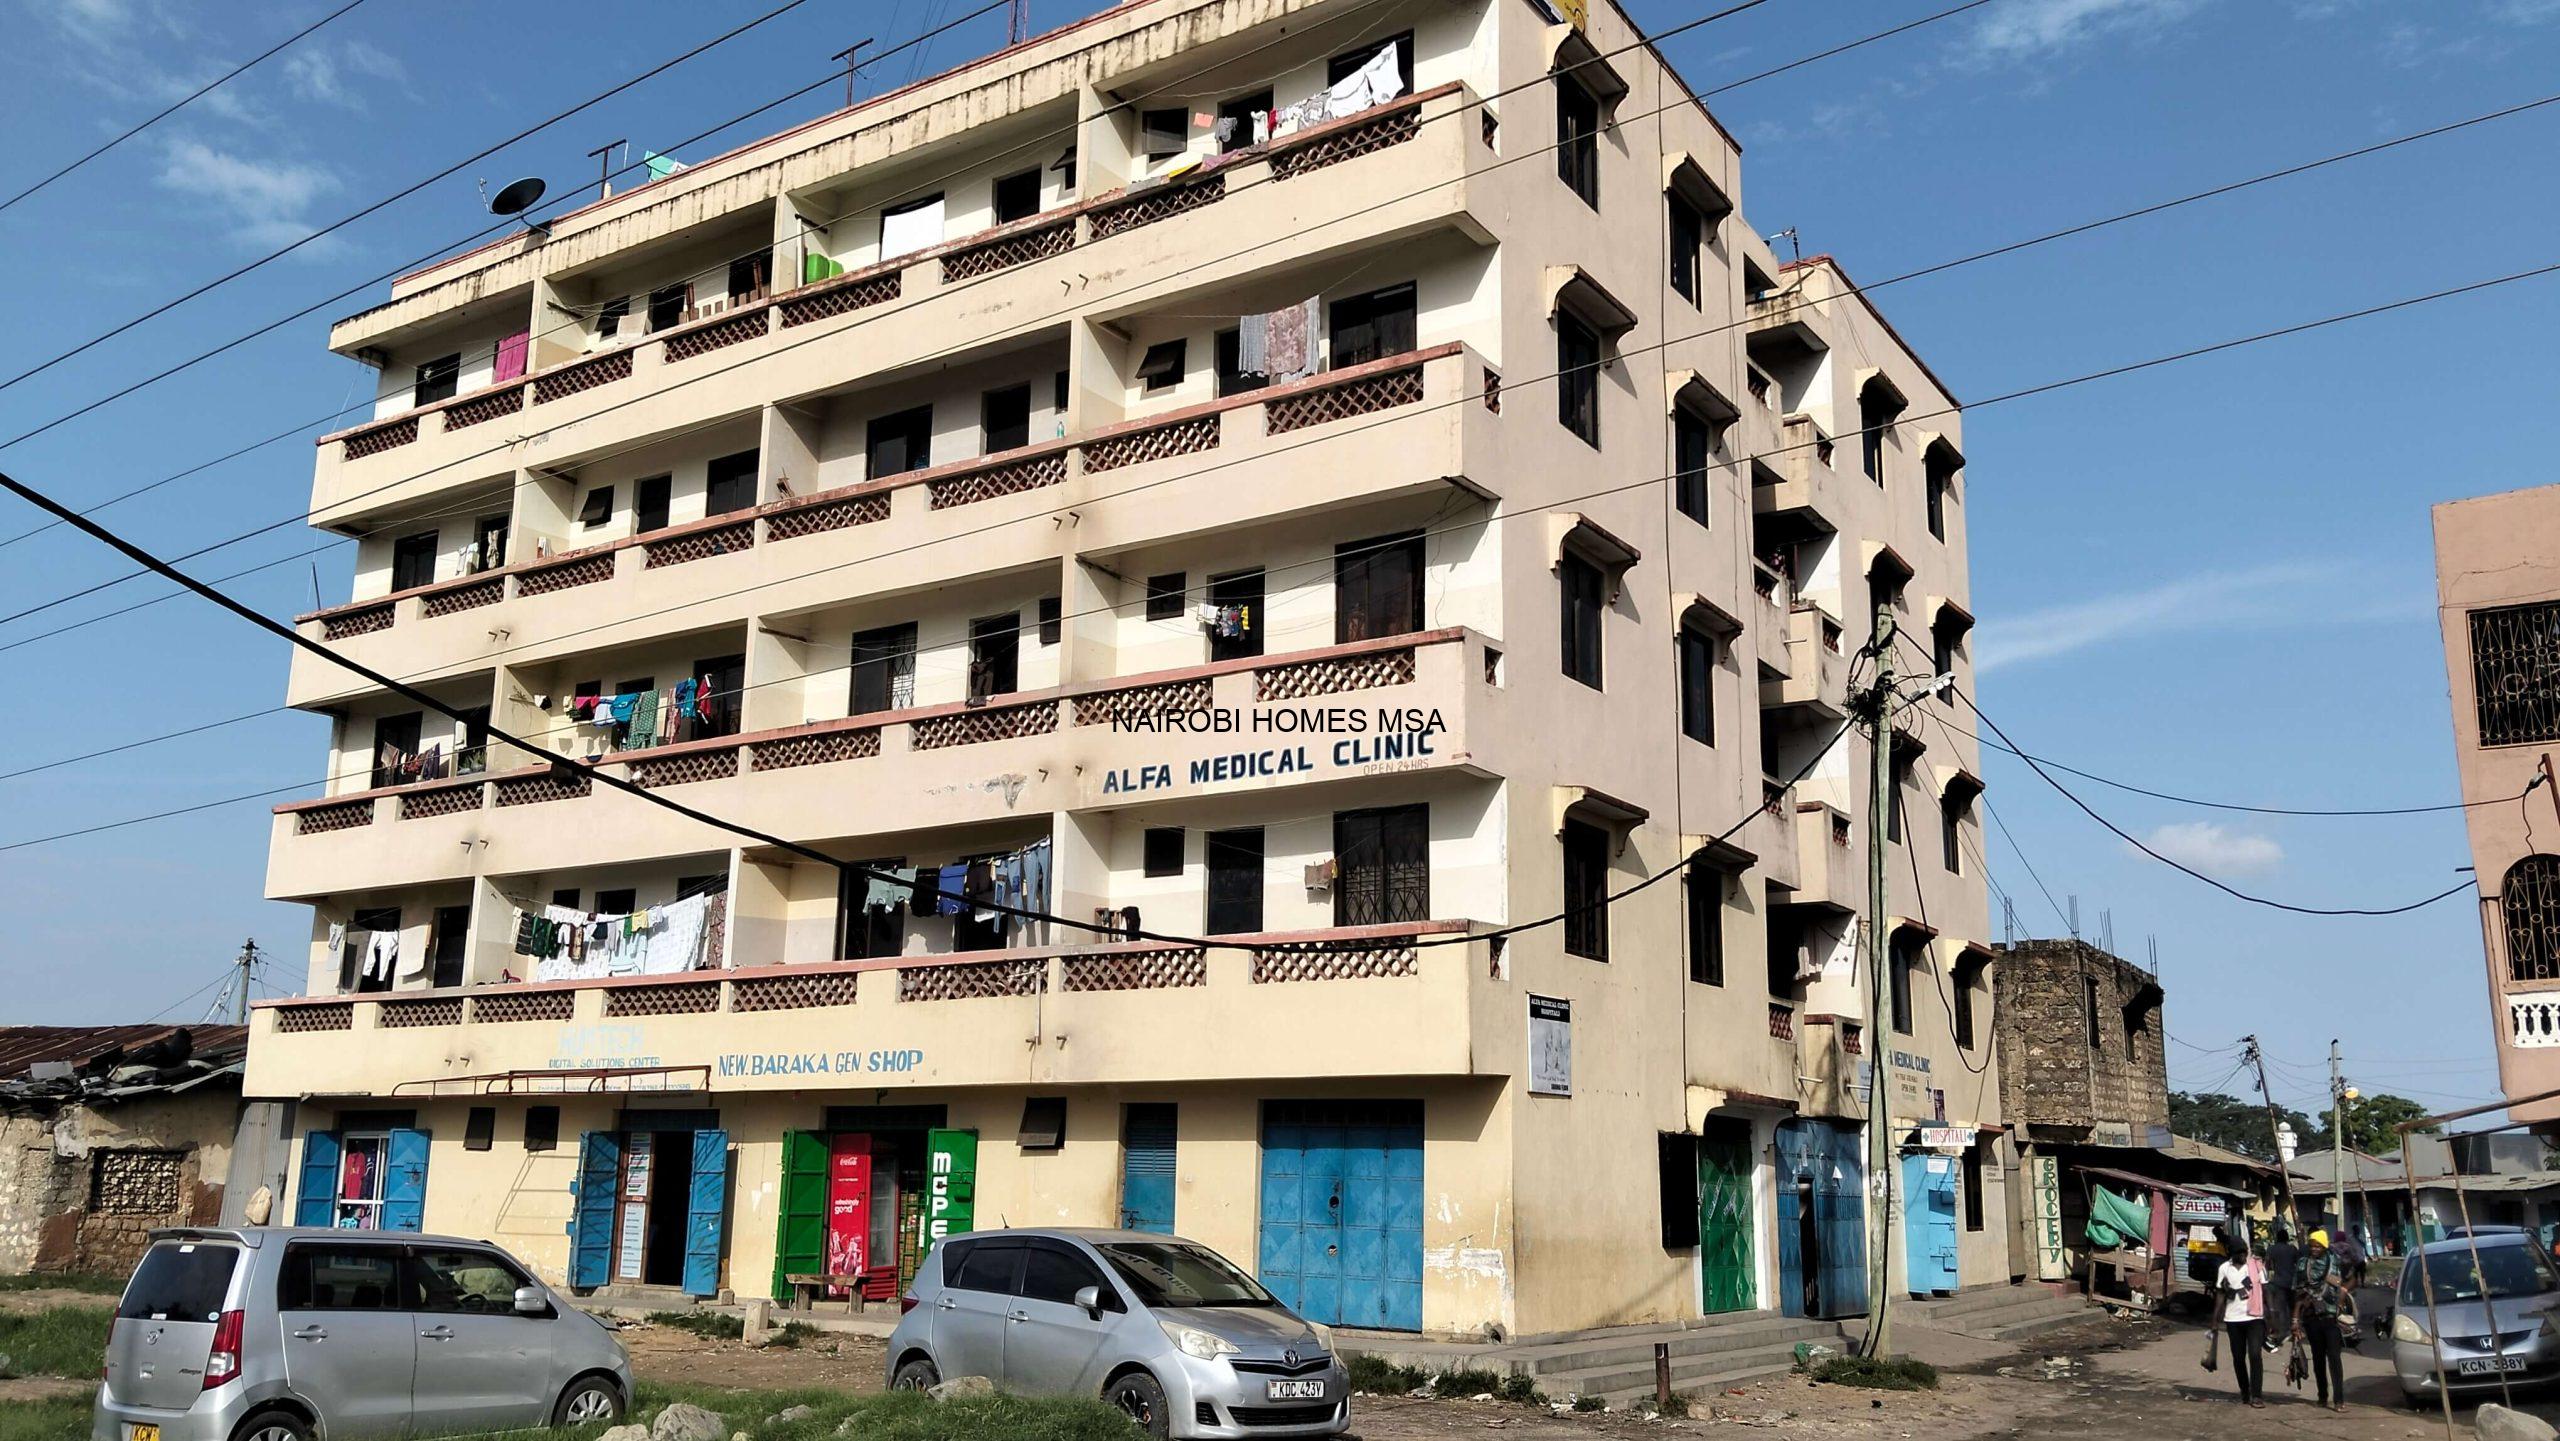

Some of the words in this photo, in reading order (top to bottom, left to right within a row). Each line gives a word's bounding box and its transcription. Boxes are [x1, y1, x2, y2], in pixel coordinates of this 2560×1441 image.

[1103, 764, 1172, 794] ALFA
[1190, 746, 1313, 784] MEDICAL
[1333, 729, 1434, 767] CLINIC
[1363, 763, 1393, 775] OPEN
[549, 1058, 576, 1068] DIGITAL
[580, 1057, 625, 1068] SOLUTIONS
[629, 1056, 660, 1067] CENTER
[836, 1052, 862, 1073] GEN
[867, 1050, 923, 1072] SHOP
[1930, 1129, 1967, 1143] HOSPITALI
[2043, 1158, 2061, 1263] GROCERY
[2174, 1200, 2223, 1212] SALON
[2461, 1360, 2487, 1373] KCN
[1280, 1382, 1297, 1397] KDC
[1300, 1382, 1321, 1397] 423Y
